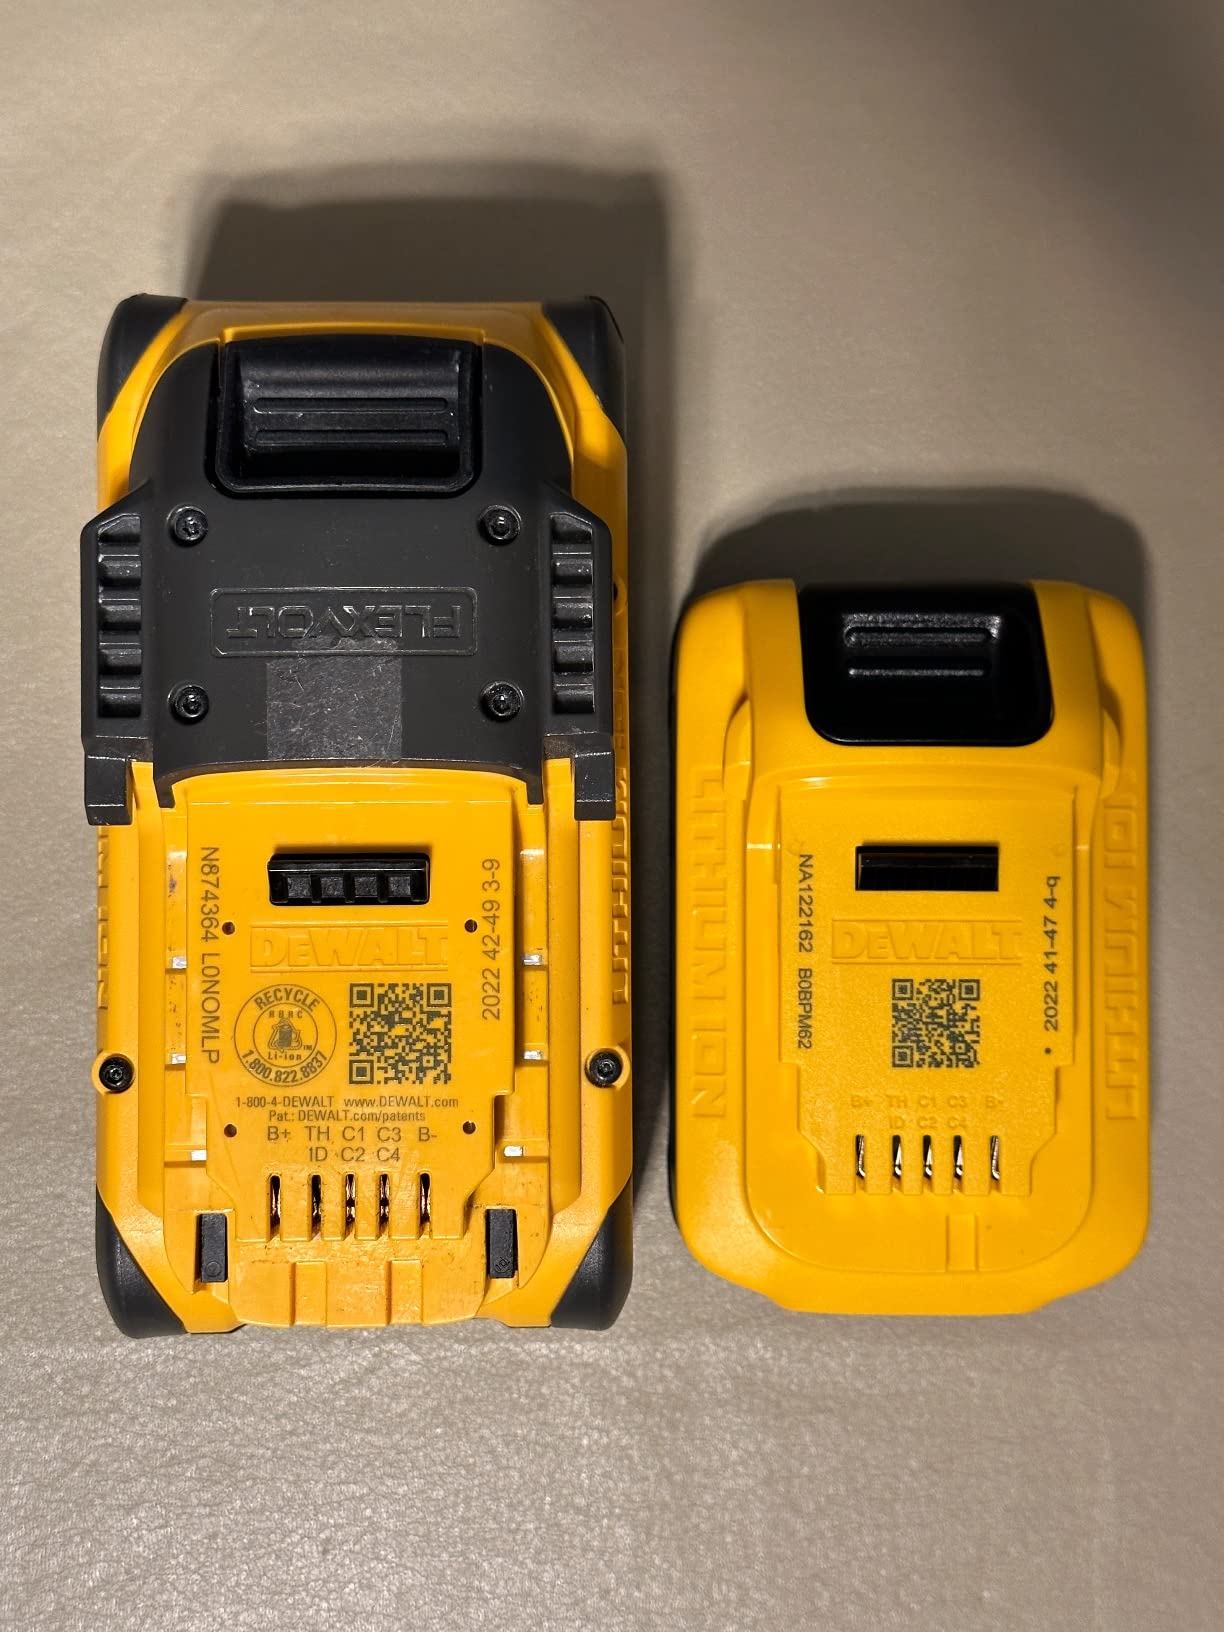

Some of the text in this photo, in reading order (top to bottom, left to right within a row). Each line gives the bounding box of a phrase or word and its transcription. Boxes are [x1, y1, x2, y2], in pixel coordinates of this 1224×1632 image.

[225, 604, 461, 639] FLEXVOLT
[201, 846, 219, 943] N874364
[798, 853, 814, 953] NA122162
[250, 927, 449, 967] DEWALT
[481, 858, 501, 1021] 2022 42-49 3-9
[692, 770, 727, 1118] LITHIUM ION
[831, 920, 1023, 960] DEWALT
[1043, 915, 1058, 975] 41-47
[254, 987, 320, 1012] RECYCLE
[1043, 980, 1059, 1032] 2022
[1104, 888, 1137, 1120] LITHIUM
[242, 1049, 328, 1084] 1.800.822.8837
[267, 1051, 302, 1061] Li-ion
[236, 1095, 459, 1109] 1-800-4-DEWALT www.DEWALT.com
[298, 1109, 426, 1123] DEWALT.com/patents
[267, 1125, 438, 1142] B+ TH C1 C3 B-
[340, 1146, 365, 1162] C2
[376, 1146, 401, 1162] C4
